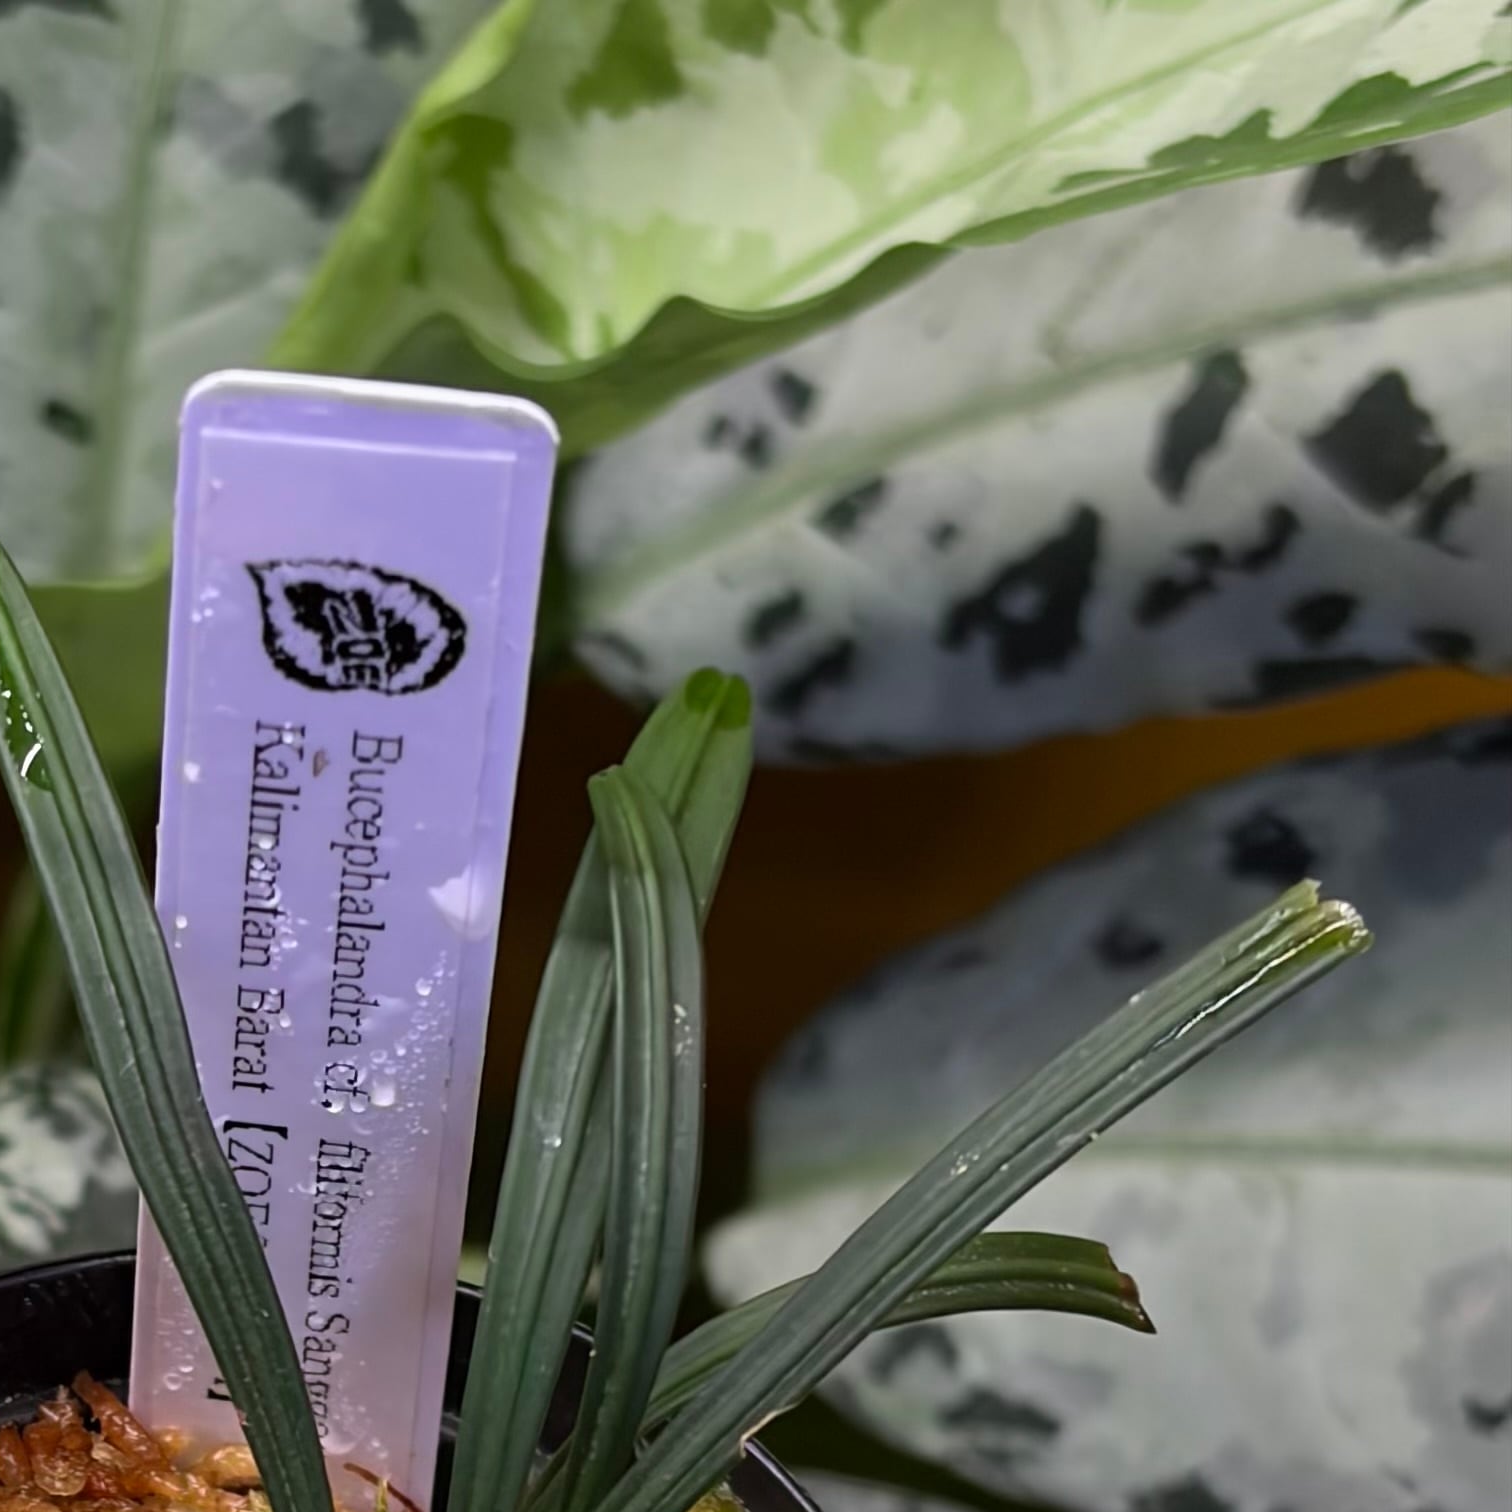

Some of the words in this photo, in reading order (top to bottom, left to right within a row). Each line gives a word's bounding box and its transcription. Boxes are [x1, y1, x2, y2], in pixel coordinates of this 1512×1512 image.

[322, 590, 387, 690] ZOE
[238, 719, 306, 969] Kalimantan
[327, 729, 404, 1048] Bucephalandra
[231, 983, 286, 1094] Barat
[307, 1138, 372, 1300] filiformis
[302, 1309, 351, 1444] Sang
